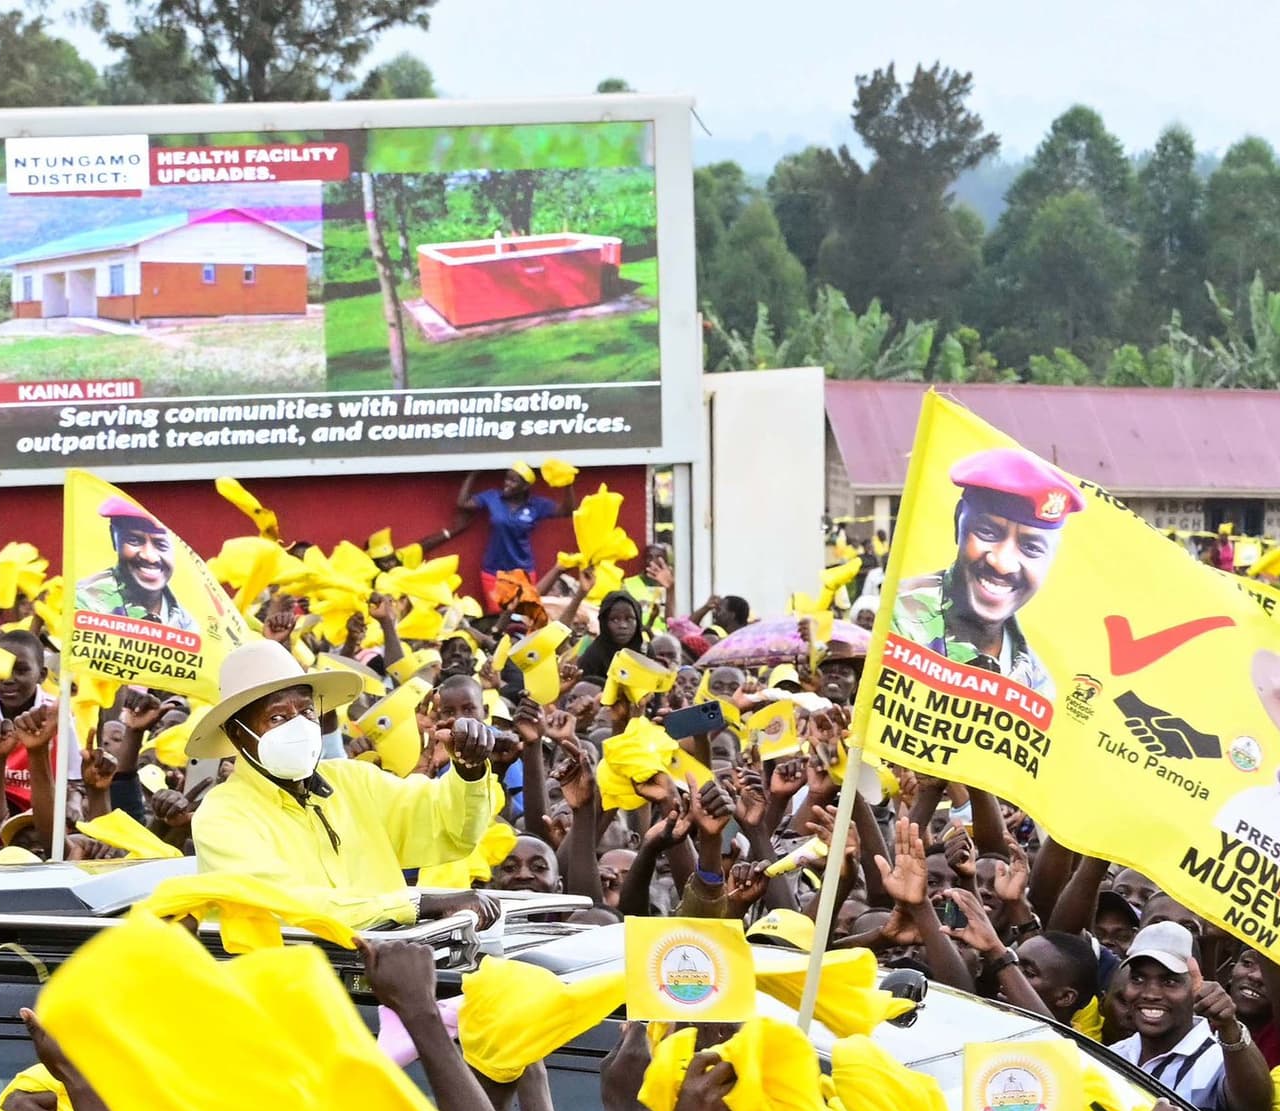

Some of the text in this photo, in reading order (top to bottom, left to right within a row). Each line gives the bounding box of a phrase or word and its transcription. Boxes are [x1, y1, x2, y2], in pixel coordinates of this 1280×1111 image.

[14, 154, 141, 169] NTUNGAMO
[157, 147, 339, 166] HEALTH FACILITY
[28, 172, 128, 186] DISTRICT:
[157, 166, 277, 184] UPGRADES.
[19, 383, 83, 401] KAINA
[59, 390, 589, 429] Serving communities with immunisation,
[17, 412, 631, 455] outpatient treatment, and counselling services.
[76, 614, 197, 648] CHAIRMAN PLU
[118, 639, 204, 668] MUHOOZI
[89, 662, 140, 681] NEXT
[877, 667, 1052, 758] EN. MUHOOZI
[1005, 687, 1046, 720] PLU
[871, 693, 1040, 780] AINERUGABA
[879, 724, 959, 766] NEXT
[1097, 732, 1212, 801] Tuko Pamoja
[1222, 906, 1279, 949] NOW
